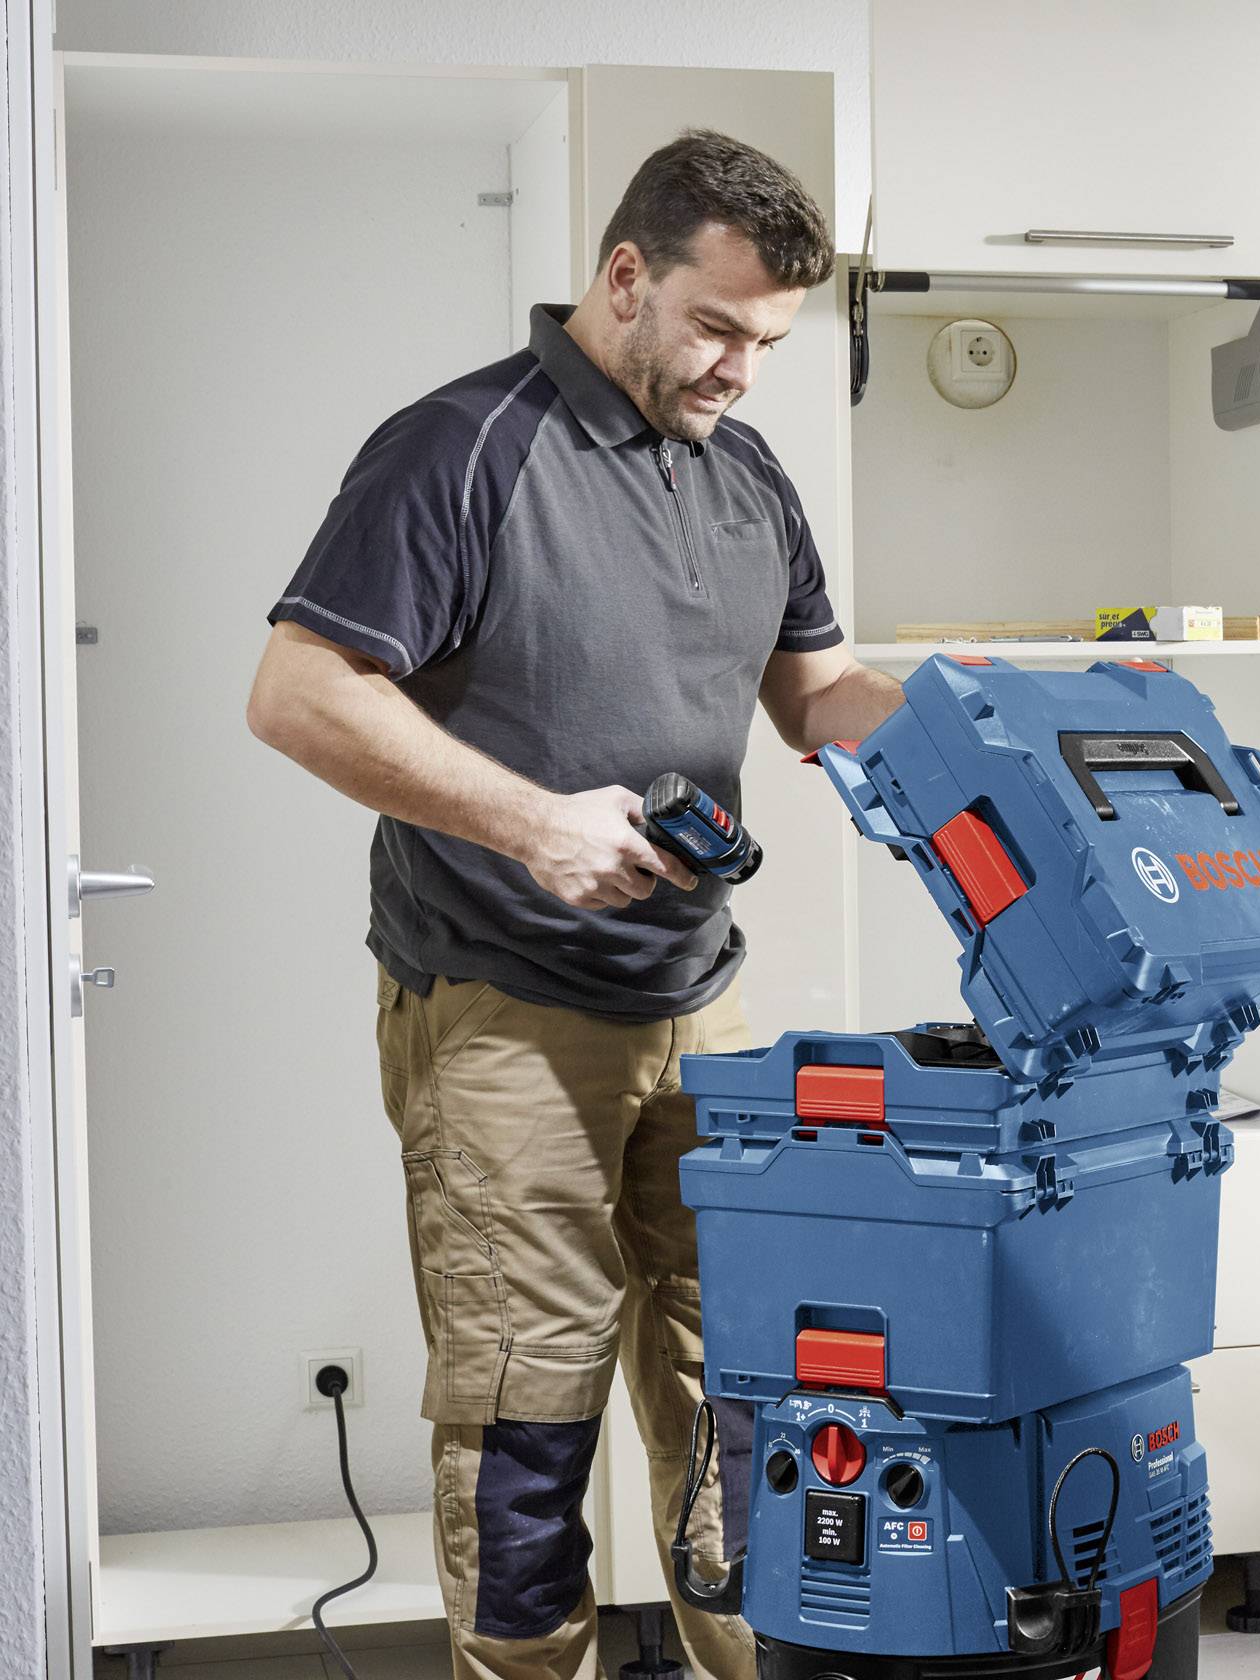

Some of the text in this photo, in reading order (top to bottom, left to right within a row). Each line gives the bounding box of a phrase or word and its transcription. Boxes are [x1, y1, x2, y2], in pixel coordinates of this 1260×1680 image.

[1147, 1420, 1180, 1453] BOSCH
[822, 1509, 839, 1517] max.
[817, 1516, 843, 1527] 2200 W
[883, 1521, 904, 1531] AFC
[822, 1528, 837, 1536] min.
[818, 1536, 841, 1546] 100 W
